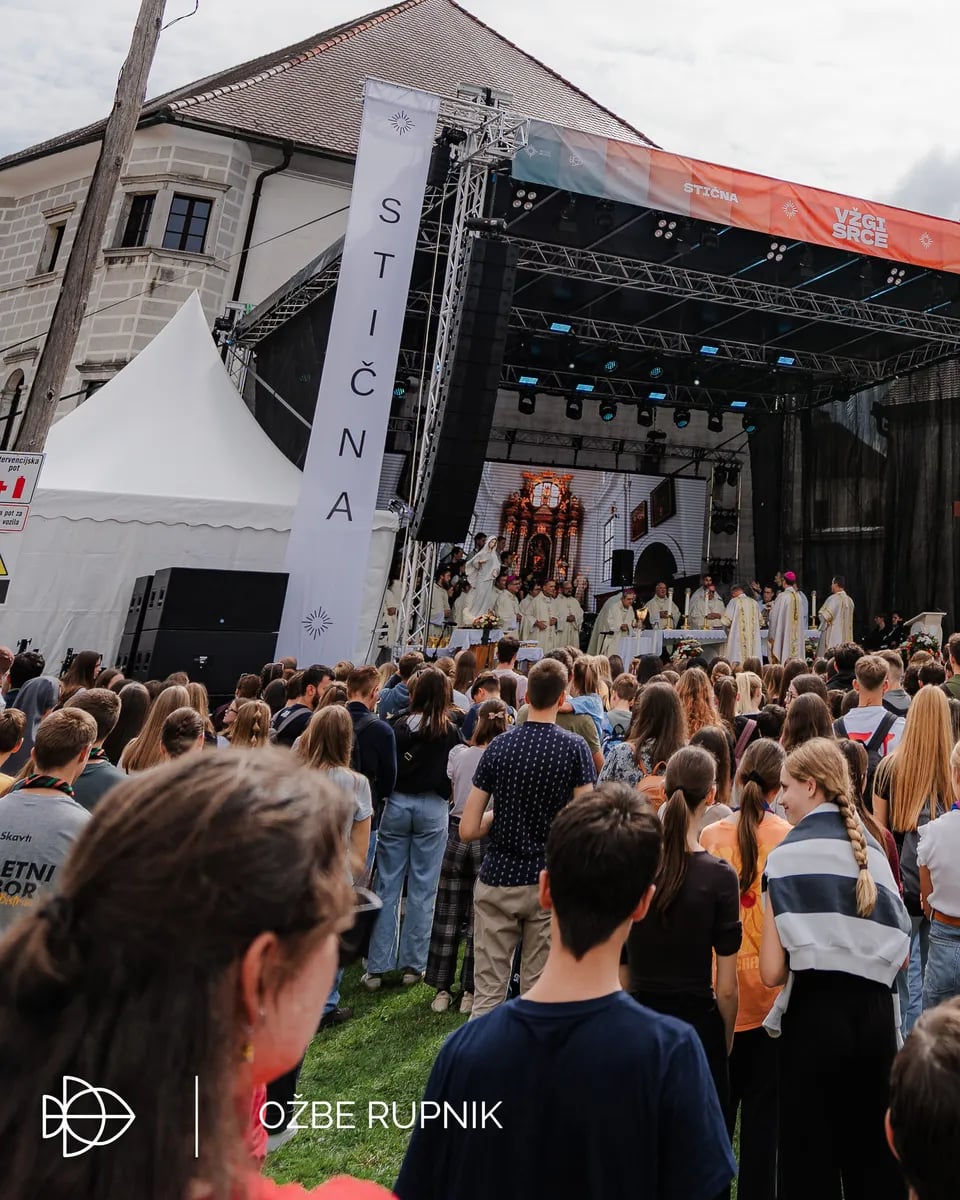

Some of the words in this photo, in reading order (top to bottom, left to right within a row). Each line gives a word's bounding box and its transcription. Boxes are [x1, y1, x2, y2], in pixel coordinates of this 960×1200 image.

[683, 182, 739, 203] STIČNA
[833, 207, 886, 233] VŽGI
[831, 223, 889, 249] SRCE
[326, 198, 402, 522] STIČNA
[4, 510, 14, 518] pot
